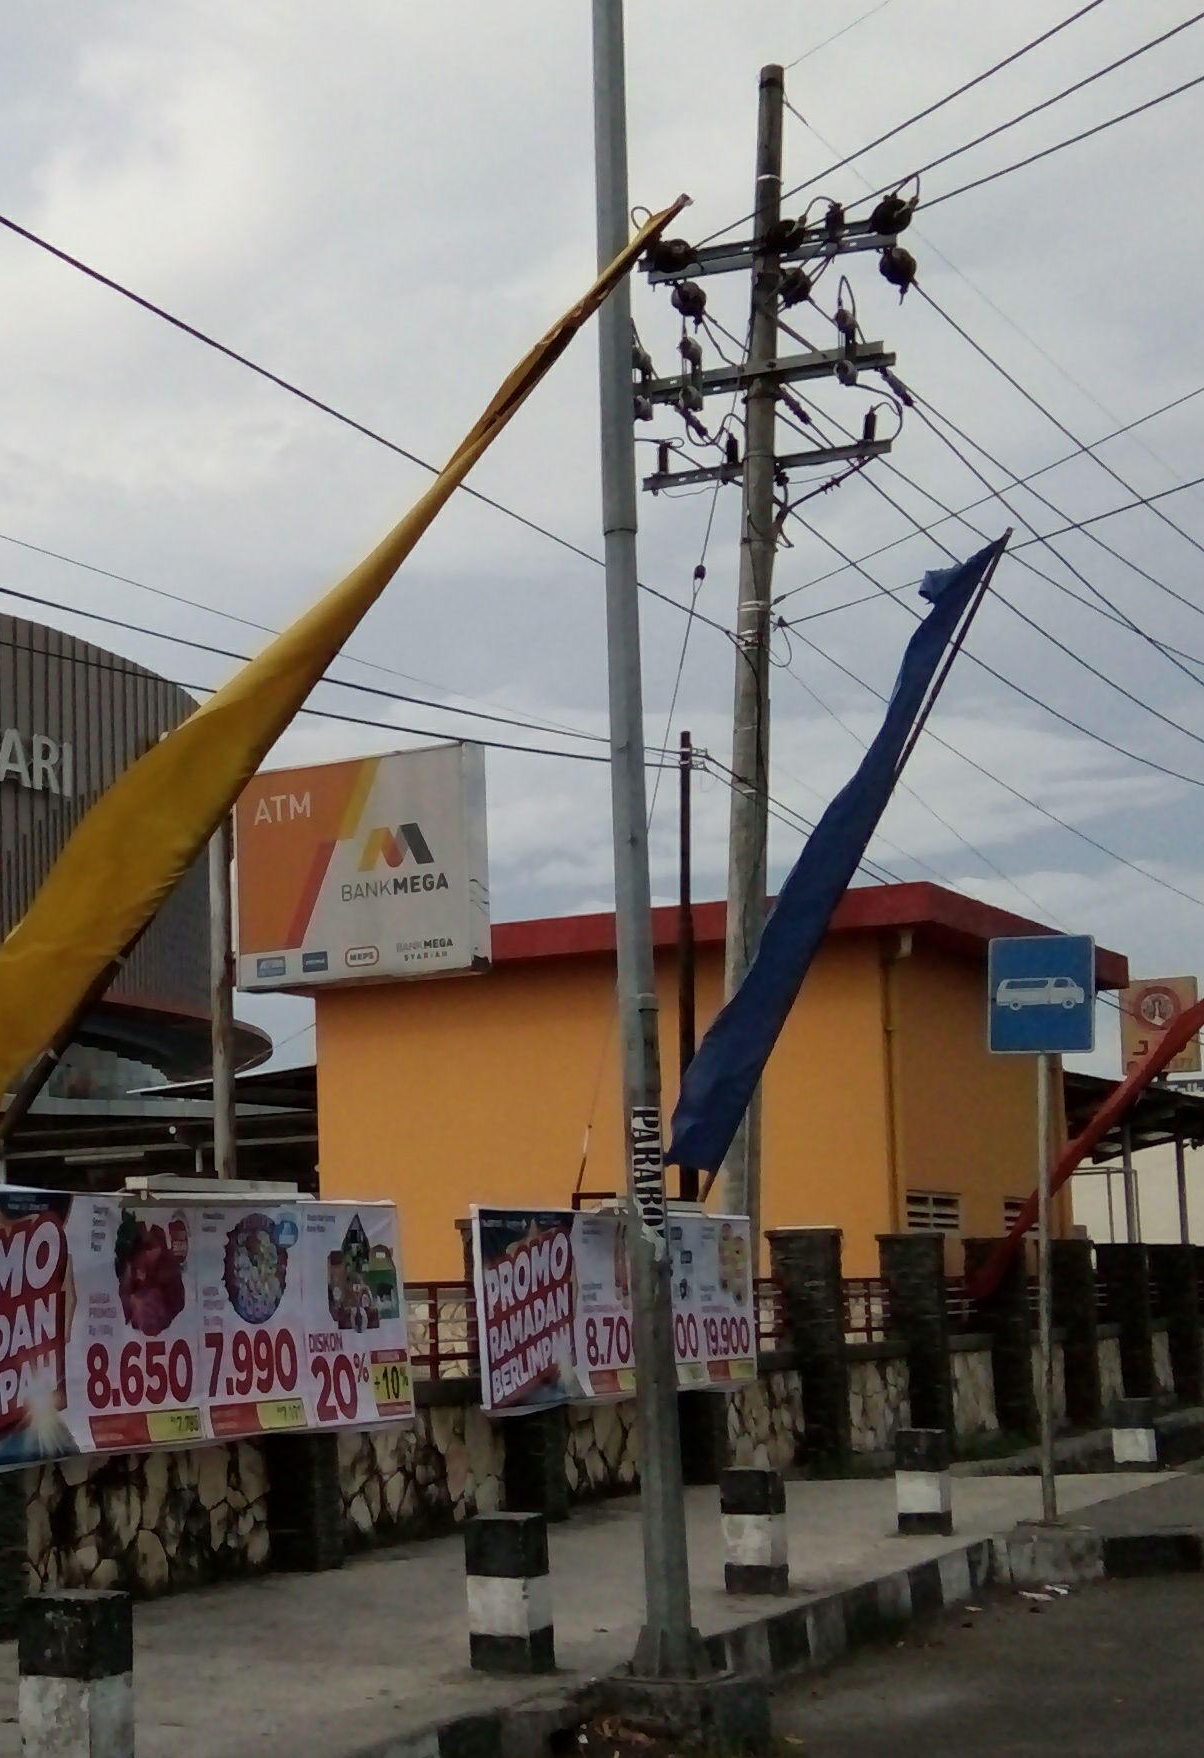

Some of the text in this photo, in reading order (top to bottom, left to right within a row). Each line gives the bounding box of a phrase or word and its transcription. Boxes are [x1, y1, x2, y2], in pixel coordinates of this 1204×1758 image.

[254, 792, 311, 826] ATM
[485, 1233, 568, 1320] PROMO
[308, 1332, 343, 1353] DISKON
[488, 1283, 569, 1363] RAMADAN
[587, 1317, 634, 1366] 8.70
[703, 1316, 750, 1356] 19.900
[86, 1338, 193, 1409] 8.650
[204, 1328, 297, 1398] 7.990
